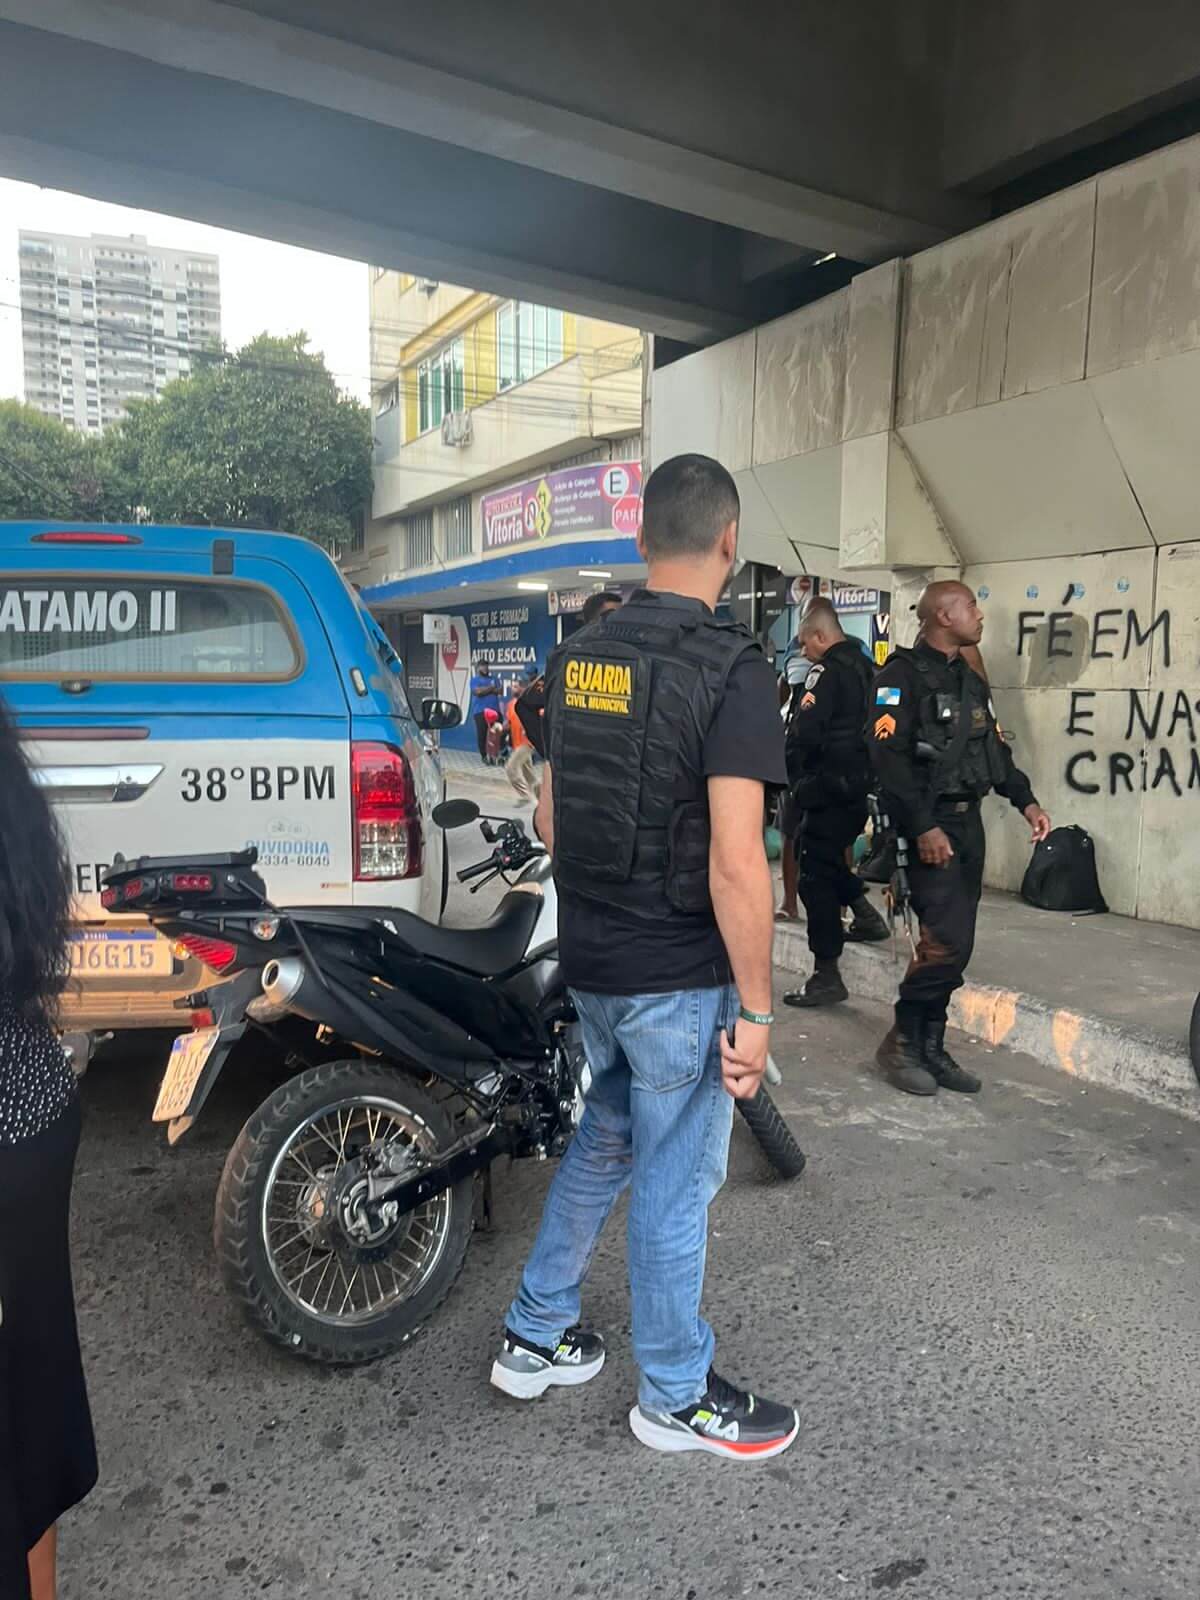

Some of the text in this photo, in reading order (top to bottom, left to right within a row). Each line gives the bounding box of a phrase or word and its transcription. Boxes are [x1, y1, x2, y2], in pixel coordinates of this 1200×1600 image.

[610, 470, 623, 494] E
[485, 514, 523, 546] Vitória
[0, 590, 176, 632] ATAMO II
[833, 587, 877, 605] Vitória
[1091, 609, 1170, 667] EM
[471, 646, 536, 663] AUTO ESCOLA
[565, 660, 632, 695] GUARDA
[566, 694, 629, 713] CIVIL MUNICIPAL
[1066, 691, 1096, 736] E
[552, 1344, 582, 1364] FILA
[689, 1409, 739, 1441] FILA
